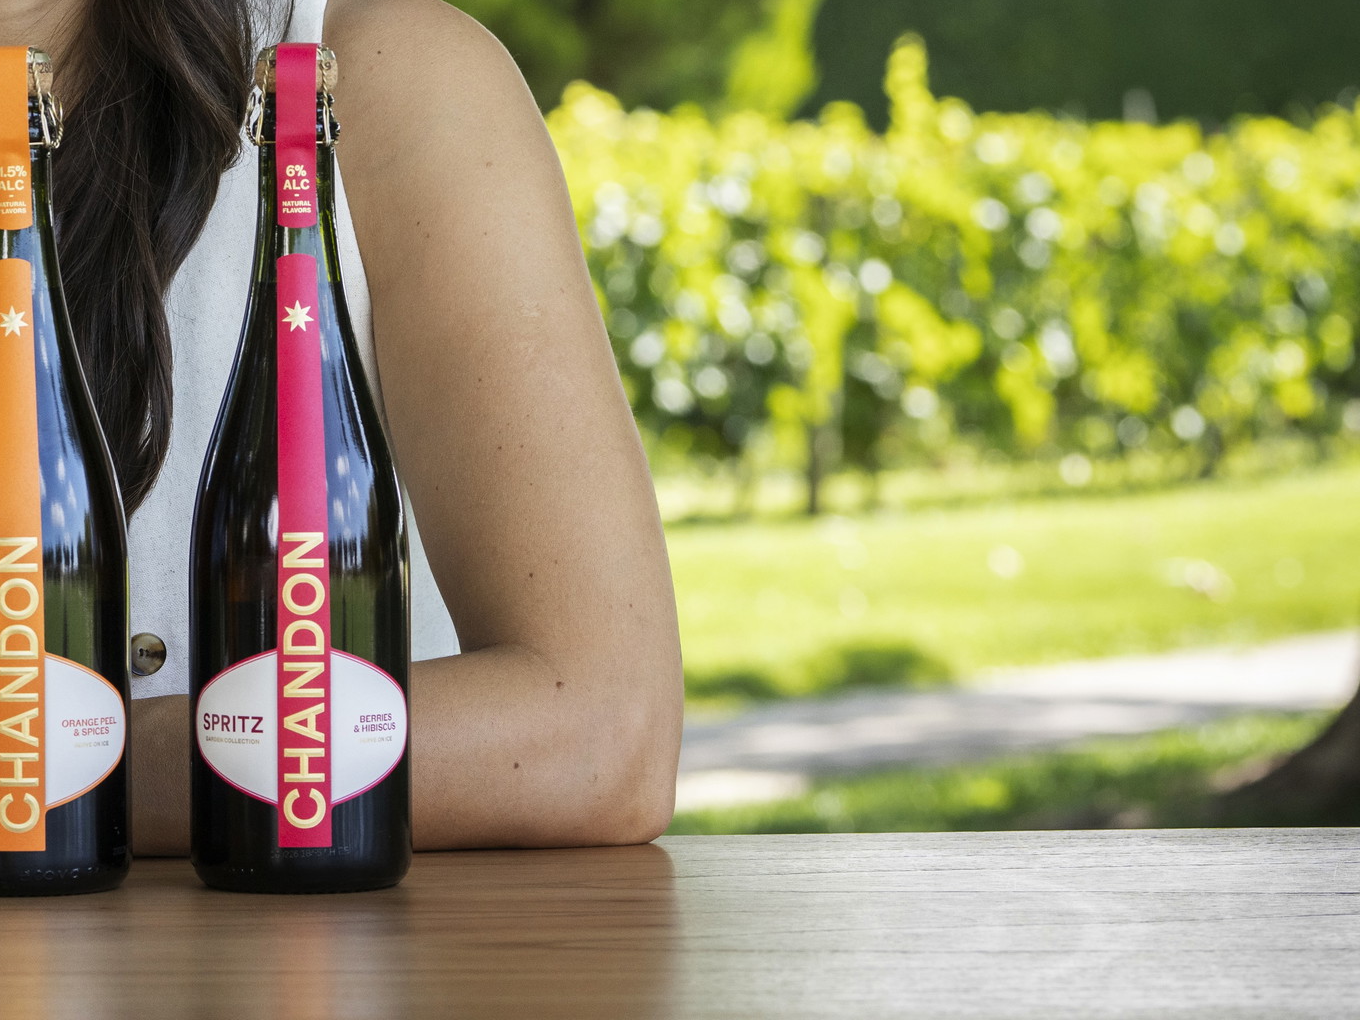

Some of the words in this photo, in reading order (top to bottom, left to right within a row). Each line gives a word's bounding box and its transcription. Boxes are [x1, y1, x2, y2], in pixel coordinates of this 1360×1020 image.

[285, 164, 307, 177] 6%
[283, 178, 310, 190] ALC
[282, 531, 326, 829] CHANDON
[61, 717, 100, 728] ORANGE
[100, 716, 117, 726] PEEL
[203, 712, 264, 734] SPRITZ
[359, 712, 393, 724] BERRIES
[73, 728, 80, 737] &
[81, 726, 110, 737] SPICES
[353, 724, 360, 733] &
[361, 721, 397, 732] HIBISCUS
[224, 737, 260, 745] COLLECTION
